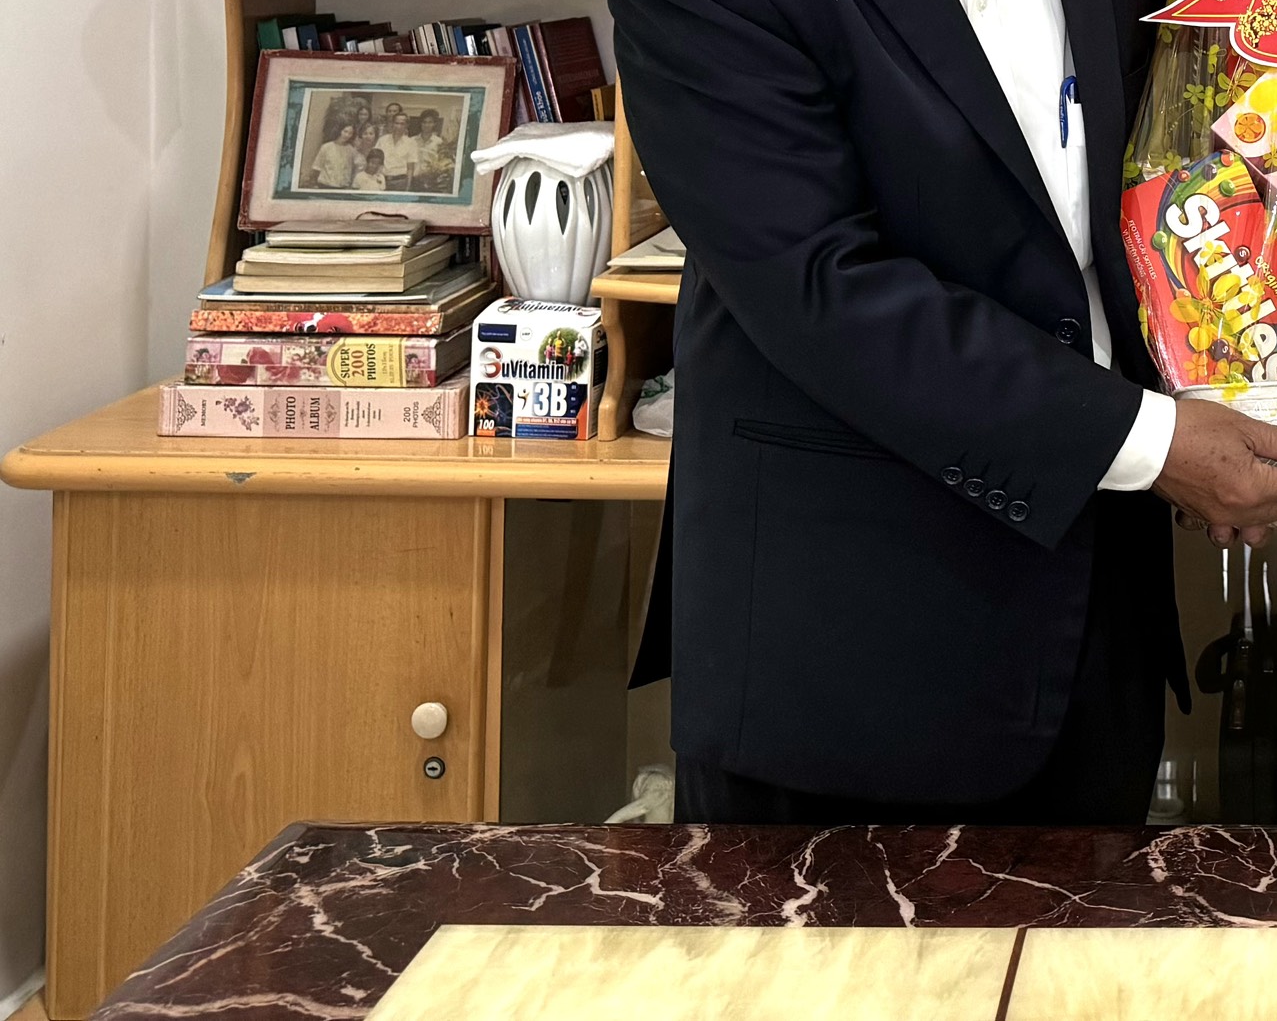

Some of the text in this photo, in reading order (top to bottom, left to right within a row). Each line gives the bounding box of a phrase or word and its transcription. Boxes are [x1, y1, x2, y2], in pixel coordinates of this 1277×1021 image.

[340, 347, 351, 379] SUPER
[352, 349, 365, 377] 200
[367, 343, 377, 380] PHOTOS
[480, 346, 564, 380] SuVitamin
[285, 396, 296, 430] PHOTO
[310, 396, 321, 431] ALBUM
[403, 406, 411, 423] 200
[533, 382, 568, 417] 3B
[478, 419, 495, 430] 100
